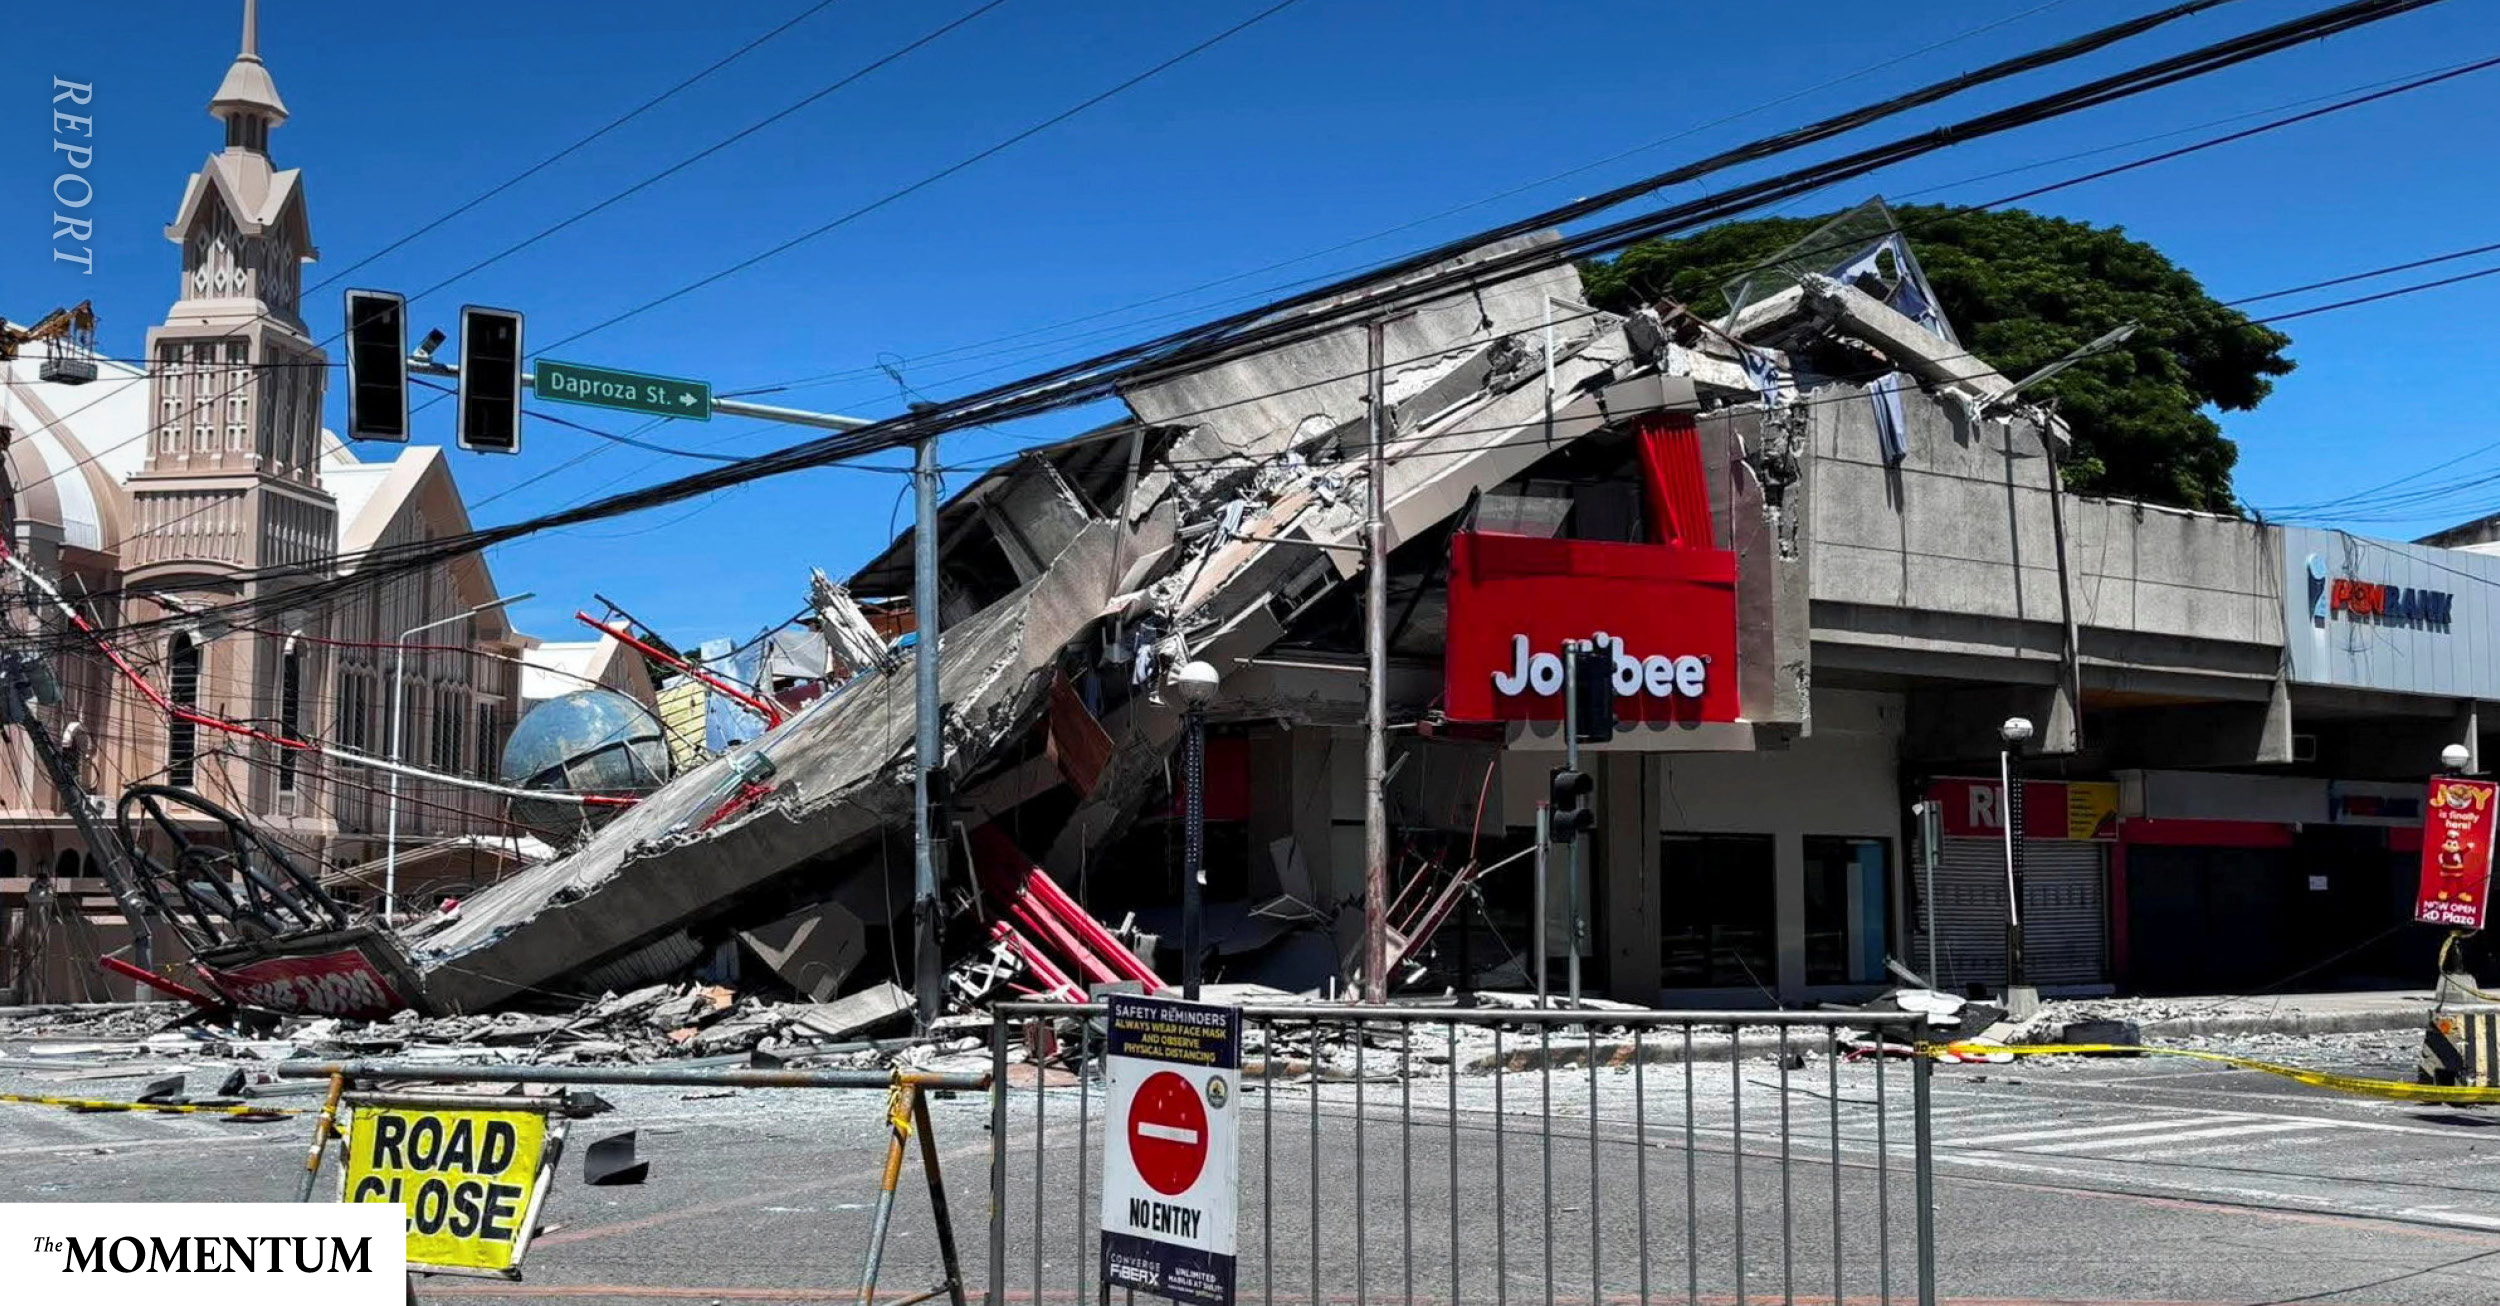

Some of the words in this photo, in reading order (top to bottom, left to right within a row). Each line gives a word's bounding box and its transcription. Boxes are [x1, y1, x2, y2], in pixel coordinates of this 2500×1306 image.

[551, 372, 637, 399] Daproza
[647, 386, 671, 405] St.
[1491, 631, 1706, 697] Jobee
[2445, 819, 2472, 830] here!
[2449, 811, 2480, 824] finally
[2423, 901, 2448, 911] NOW
[2450, 902, 2477, 914] OPEN
[2442, 912, 2475, 926] Plaza
[1115, 1004, 1157, 1020] SAFETY
[1160, 1008, 1227, 1026] REMINDERS
[1115, 1019, 1150, 1032] ALWAYS
[1151, 1022, 1177, 1034] WEAR
[1179, 1025, 1201, 1036] FACE
[1202, 1027, 1226, 1039] MASK
[1141, 1033, 1160, 1043] AND
[1161, 1036, 1200, 1048] OBSERVE
[1124, 1042, 1164, 1057] PHYSICAL
[1165, 1047, 1216, 1062] DISTANCING
[372, 1115, 516, 1175] ROAD
[1129, 1198, 1150, 1228] NO
[1152, 1202, 1201, 1239] ENTRY
[1110, 1252, 1160, 1272] CONVERGE
[1175, 1267, 1216, 1283] UNLIMITED
